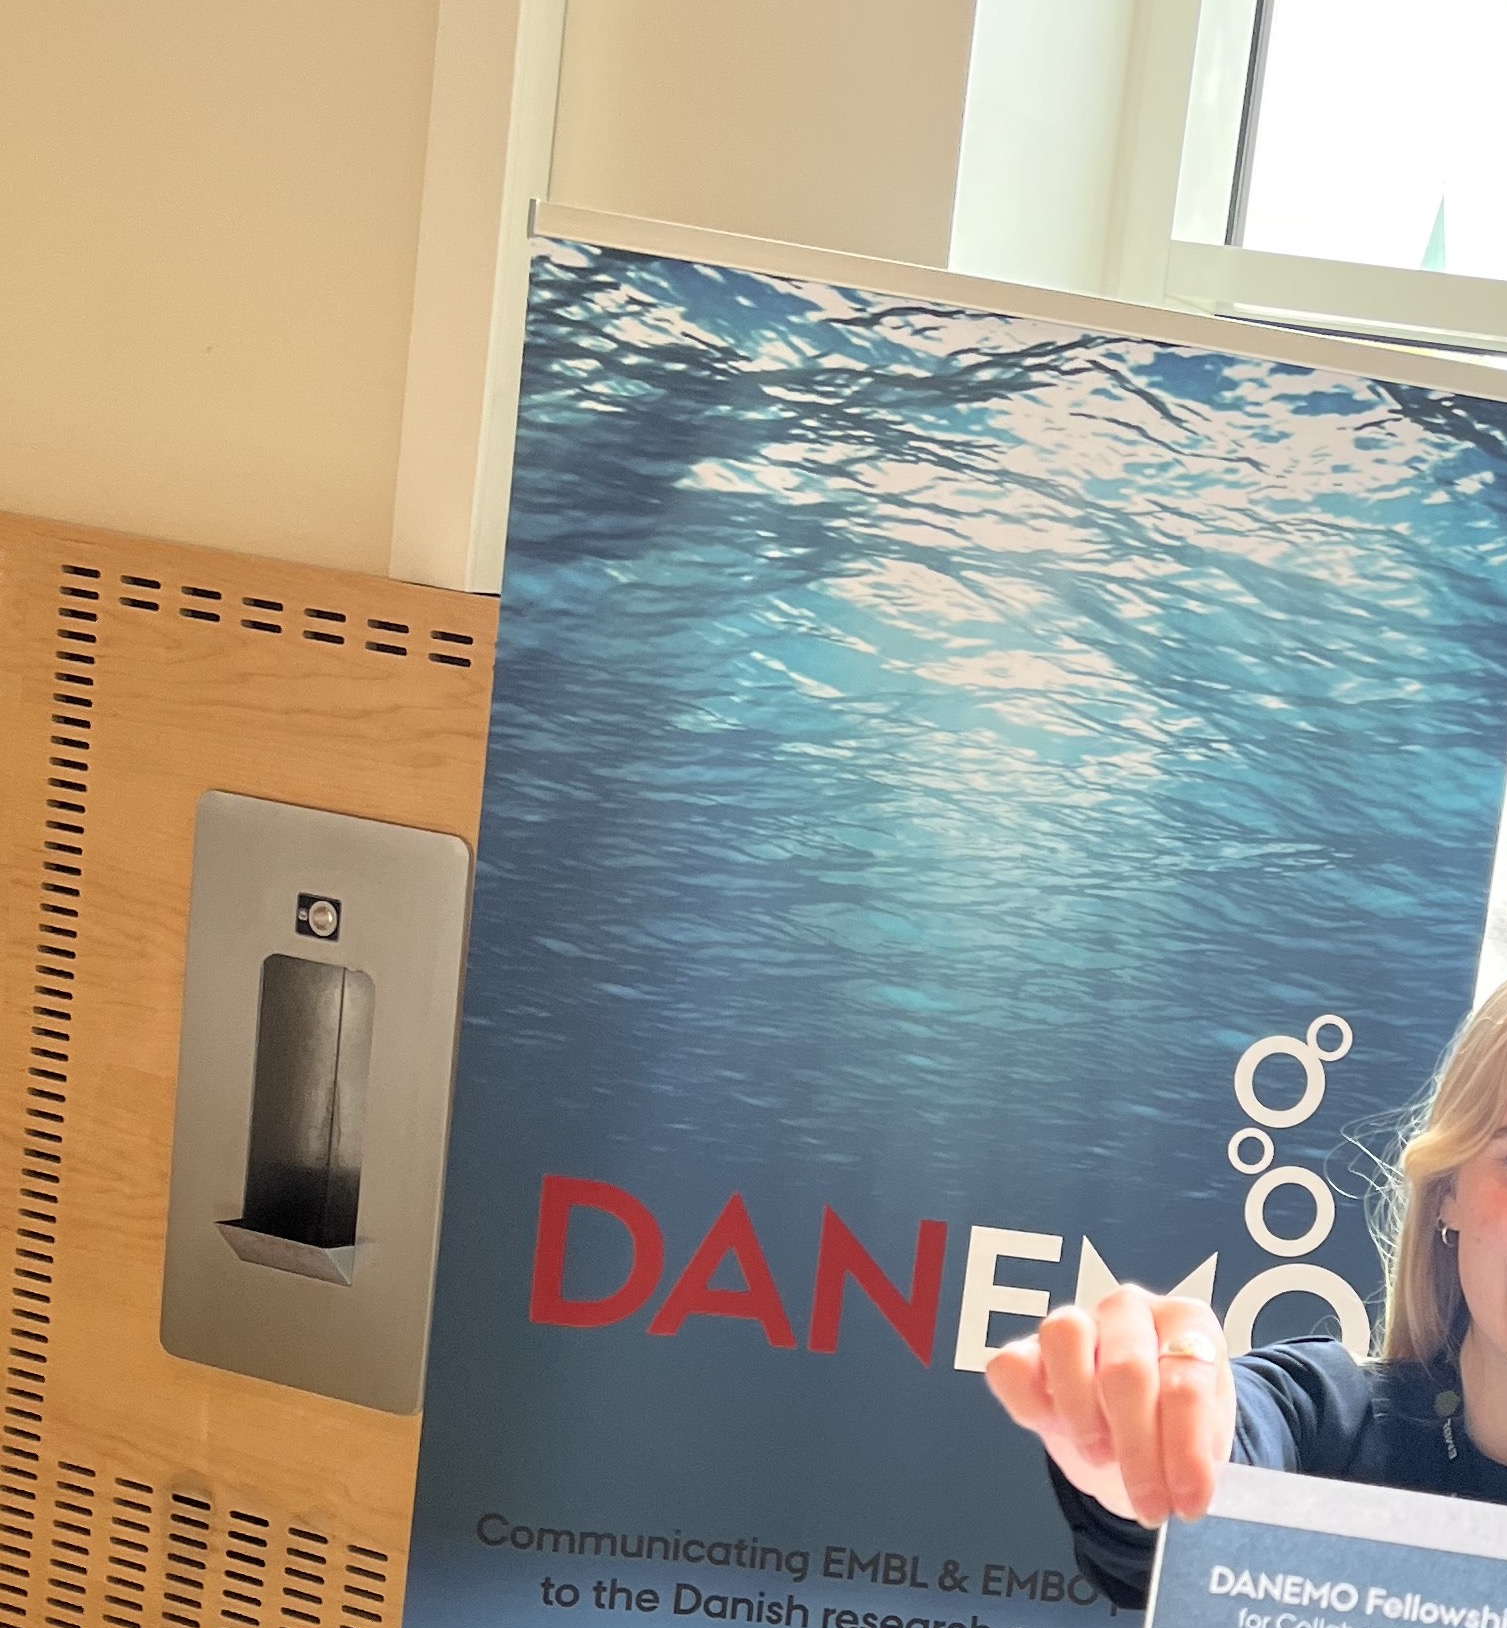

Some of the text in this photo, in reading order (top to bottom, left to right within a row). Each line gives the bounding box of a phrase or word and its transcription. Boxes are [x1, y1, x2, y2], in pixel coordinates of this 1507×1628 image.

[477, 1513, 1099, 1606] Communicating EMBL & EMBO
[541, 1576, 580, 1608] to
[593, 1578, 661, 1614] the
[674, 1582, 809, 1628] Danish
[1209, 1565, 1358, 1613] DANEMO
